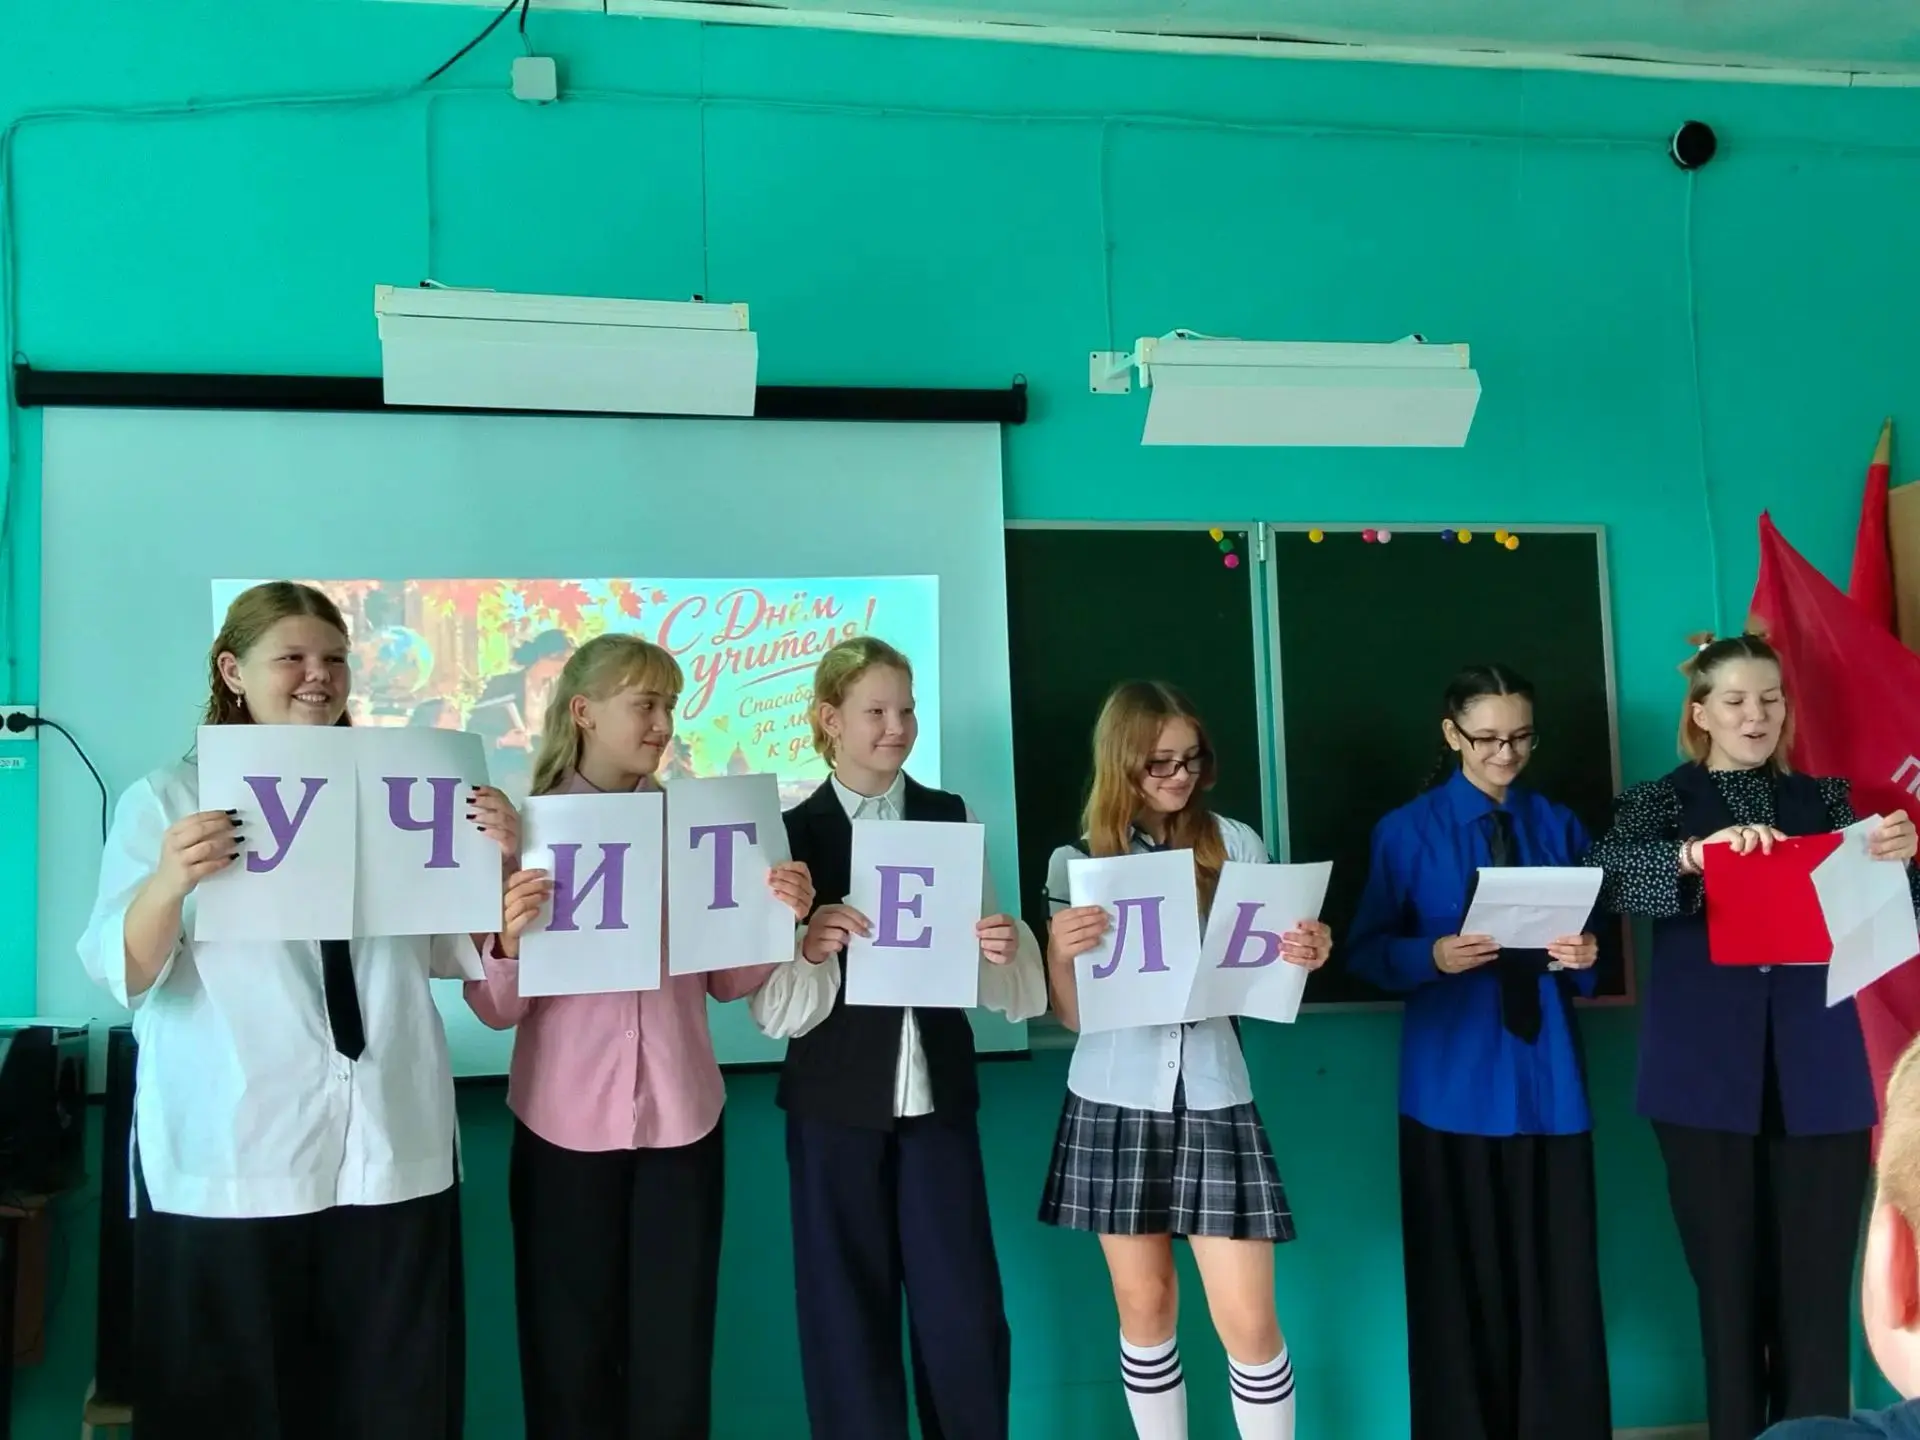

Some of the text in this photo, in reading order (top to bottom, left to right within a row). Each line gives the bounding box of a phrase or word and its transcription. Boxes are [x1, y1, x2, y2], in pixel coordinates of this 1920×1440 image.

[657, 588, 843, 656] С Днём
[752, 720, 775, 745] за
[768, 742, 780, 758] к
